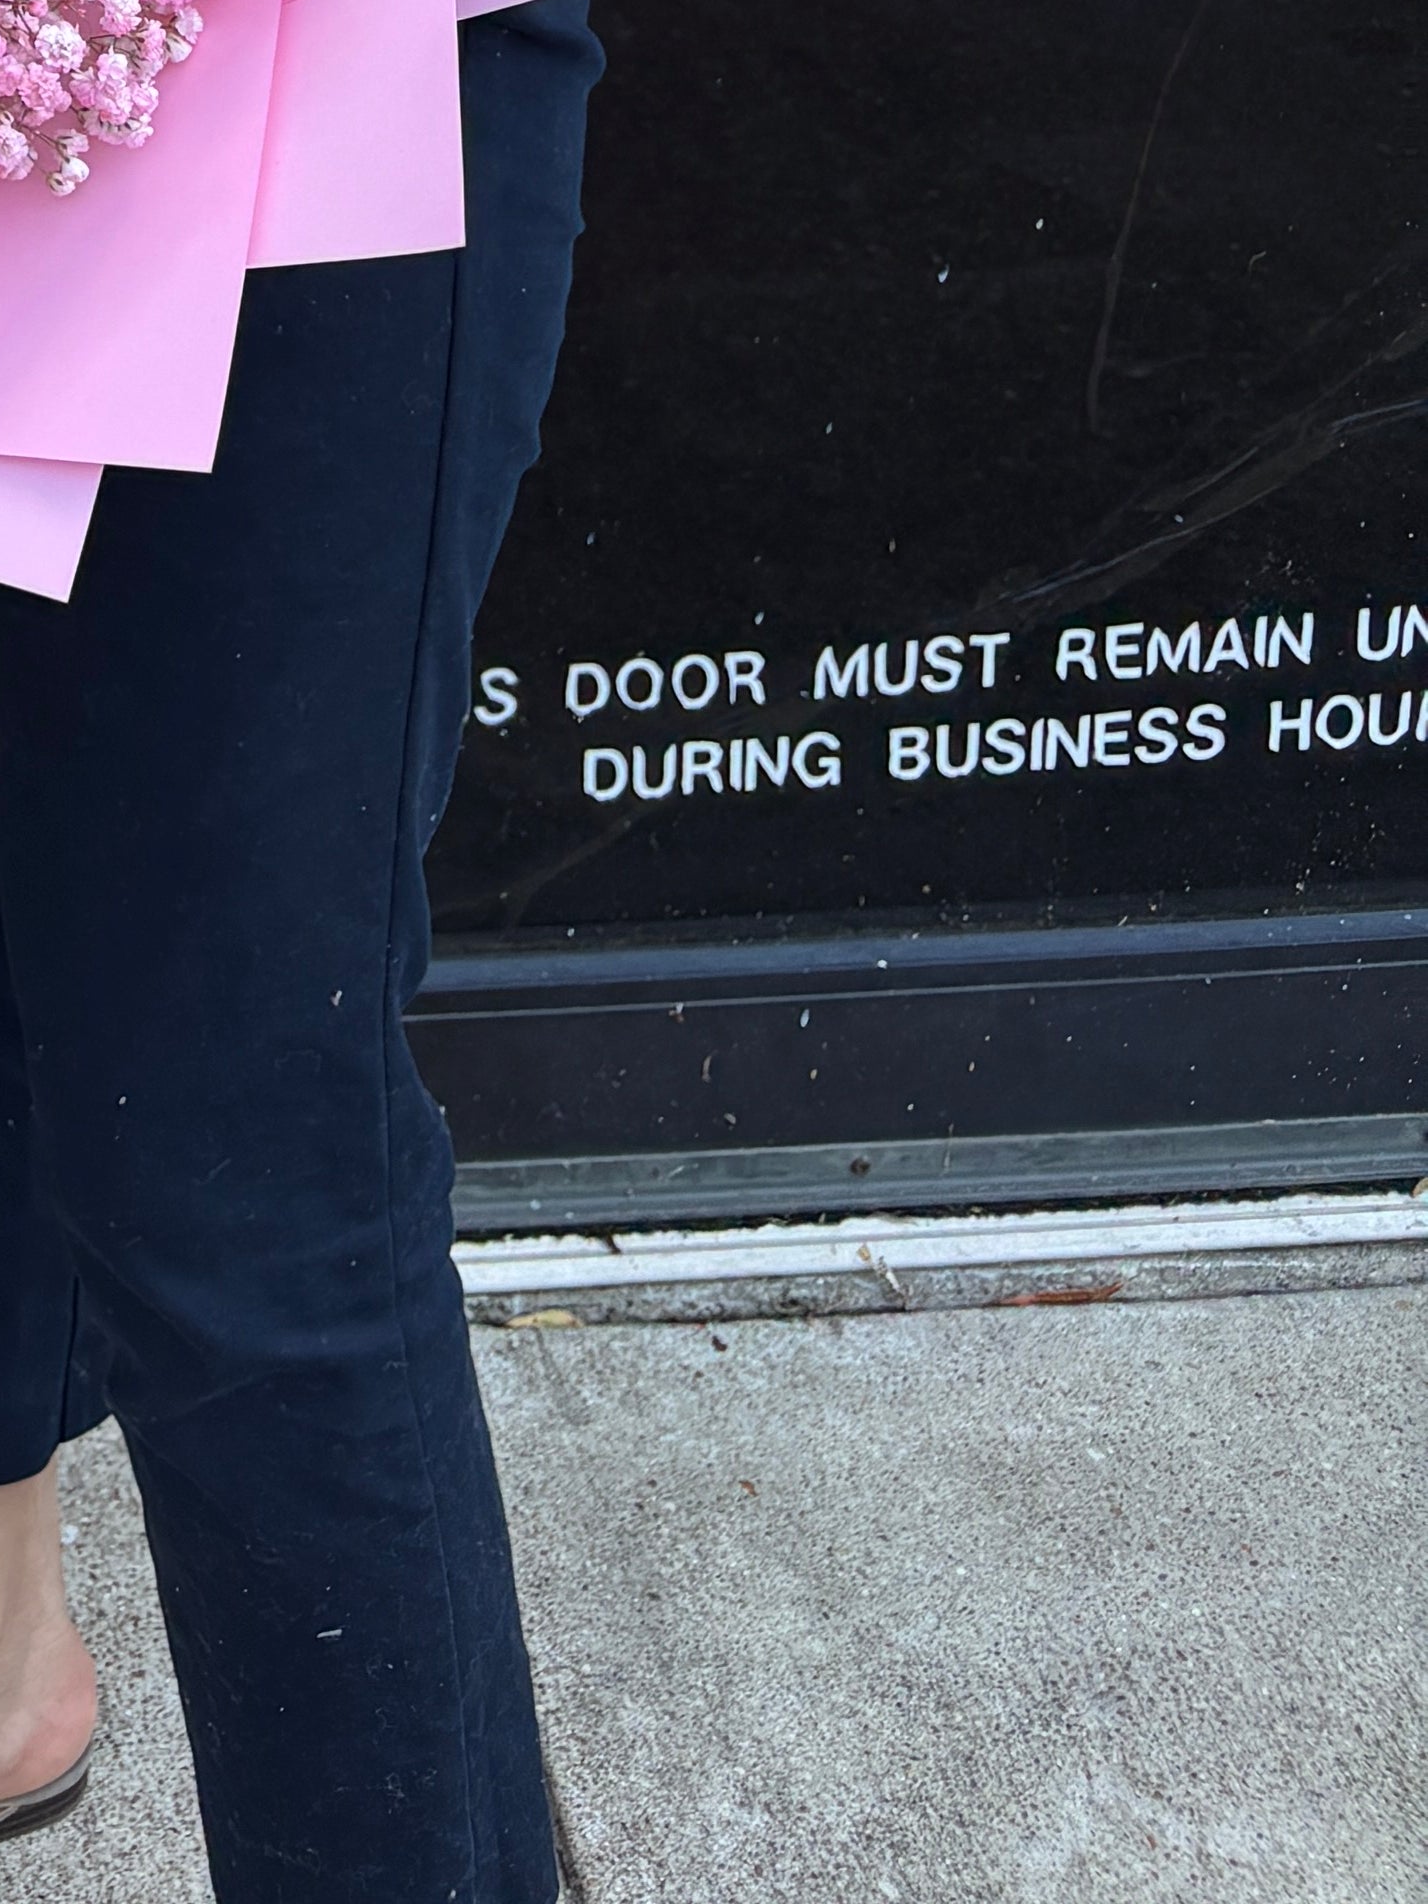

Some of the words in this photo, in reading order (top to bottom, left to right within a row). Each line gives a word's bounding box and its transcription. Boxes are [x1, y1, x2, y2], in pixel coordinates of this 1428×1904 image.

[565, 651, 766, 717] DOOR
[813, 632, 1011, 700] MUST
[1055, 612, 1314, 681] REMAIN
[583, 731, 841, 802] DURING
[888, 703, 1227, 781] BUSINESS
[1268, 690, 1428, 753] HOU
